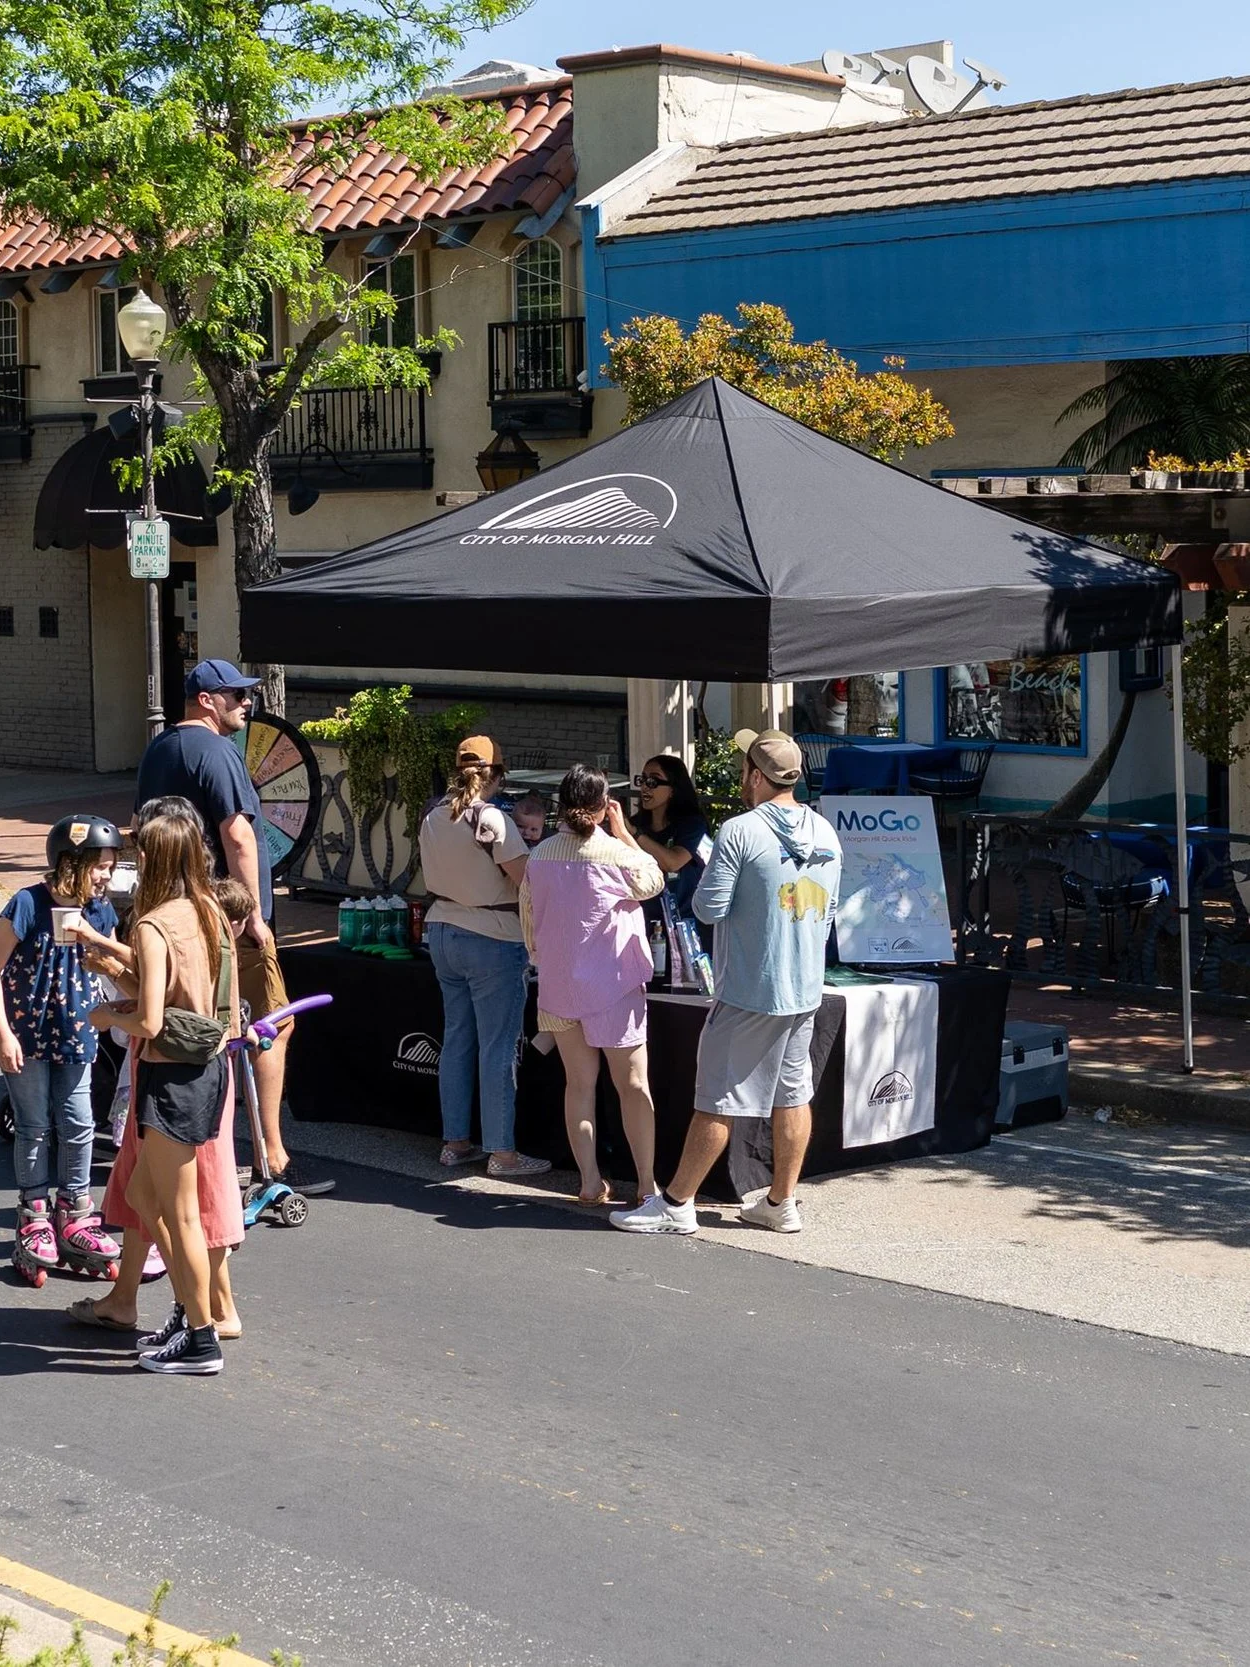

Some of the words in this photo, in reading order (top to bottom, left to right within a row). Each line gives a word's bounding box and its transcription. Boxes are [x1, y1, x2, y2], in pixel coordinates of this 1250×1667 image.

[145, 523, 157, 535] 20
[136, 534, 164, 546] MINUTE
[459, 534, 502, 545] CITY
[501, 534, 529, 545] OF
[525, 534, 611, 545] MORGAN
[610, 533, 657, 545] HILL
[134, 545, 167, 557] PARKING
[1009, 661, 1077, 693] Beach
[837, 809, 921, 831] MoGo
[844, 835, 870, 843] Morgan
